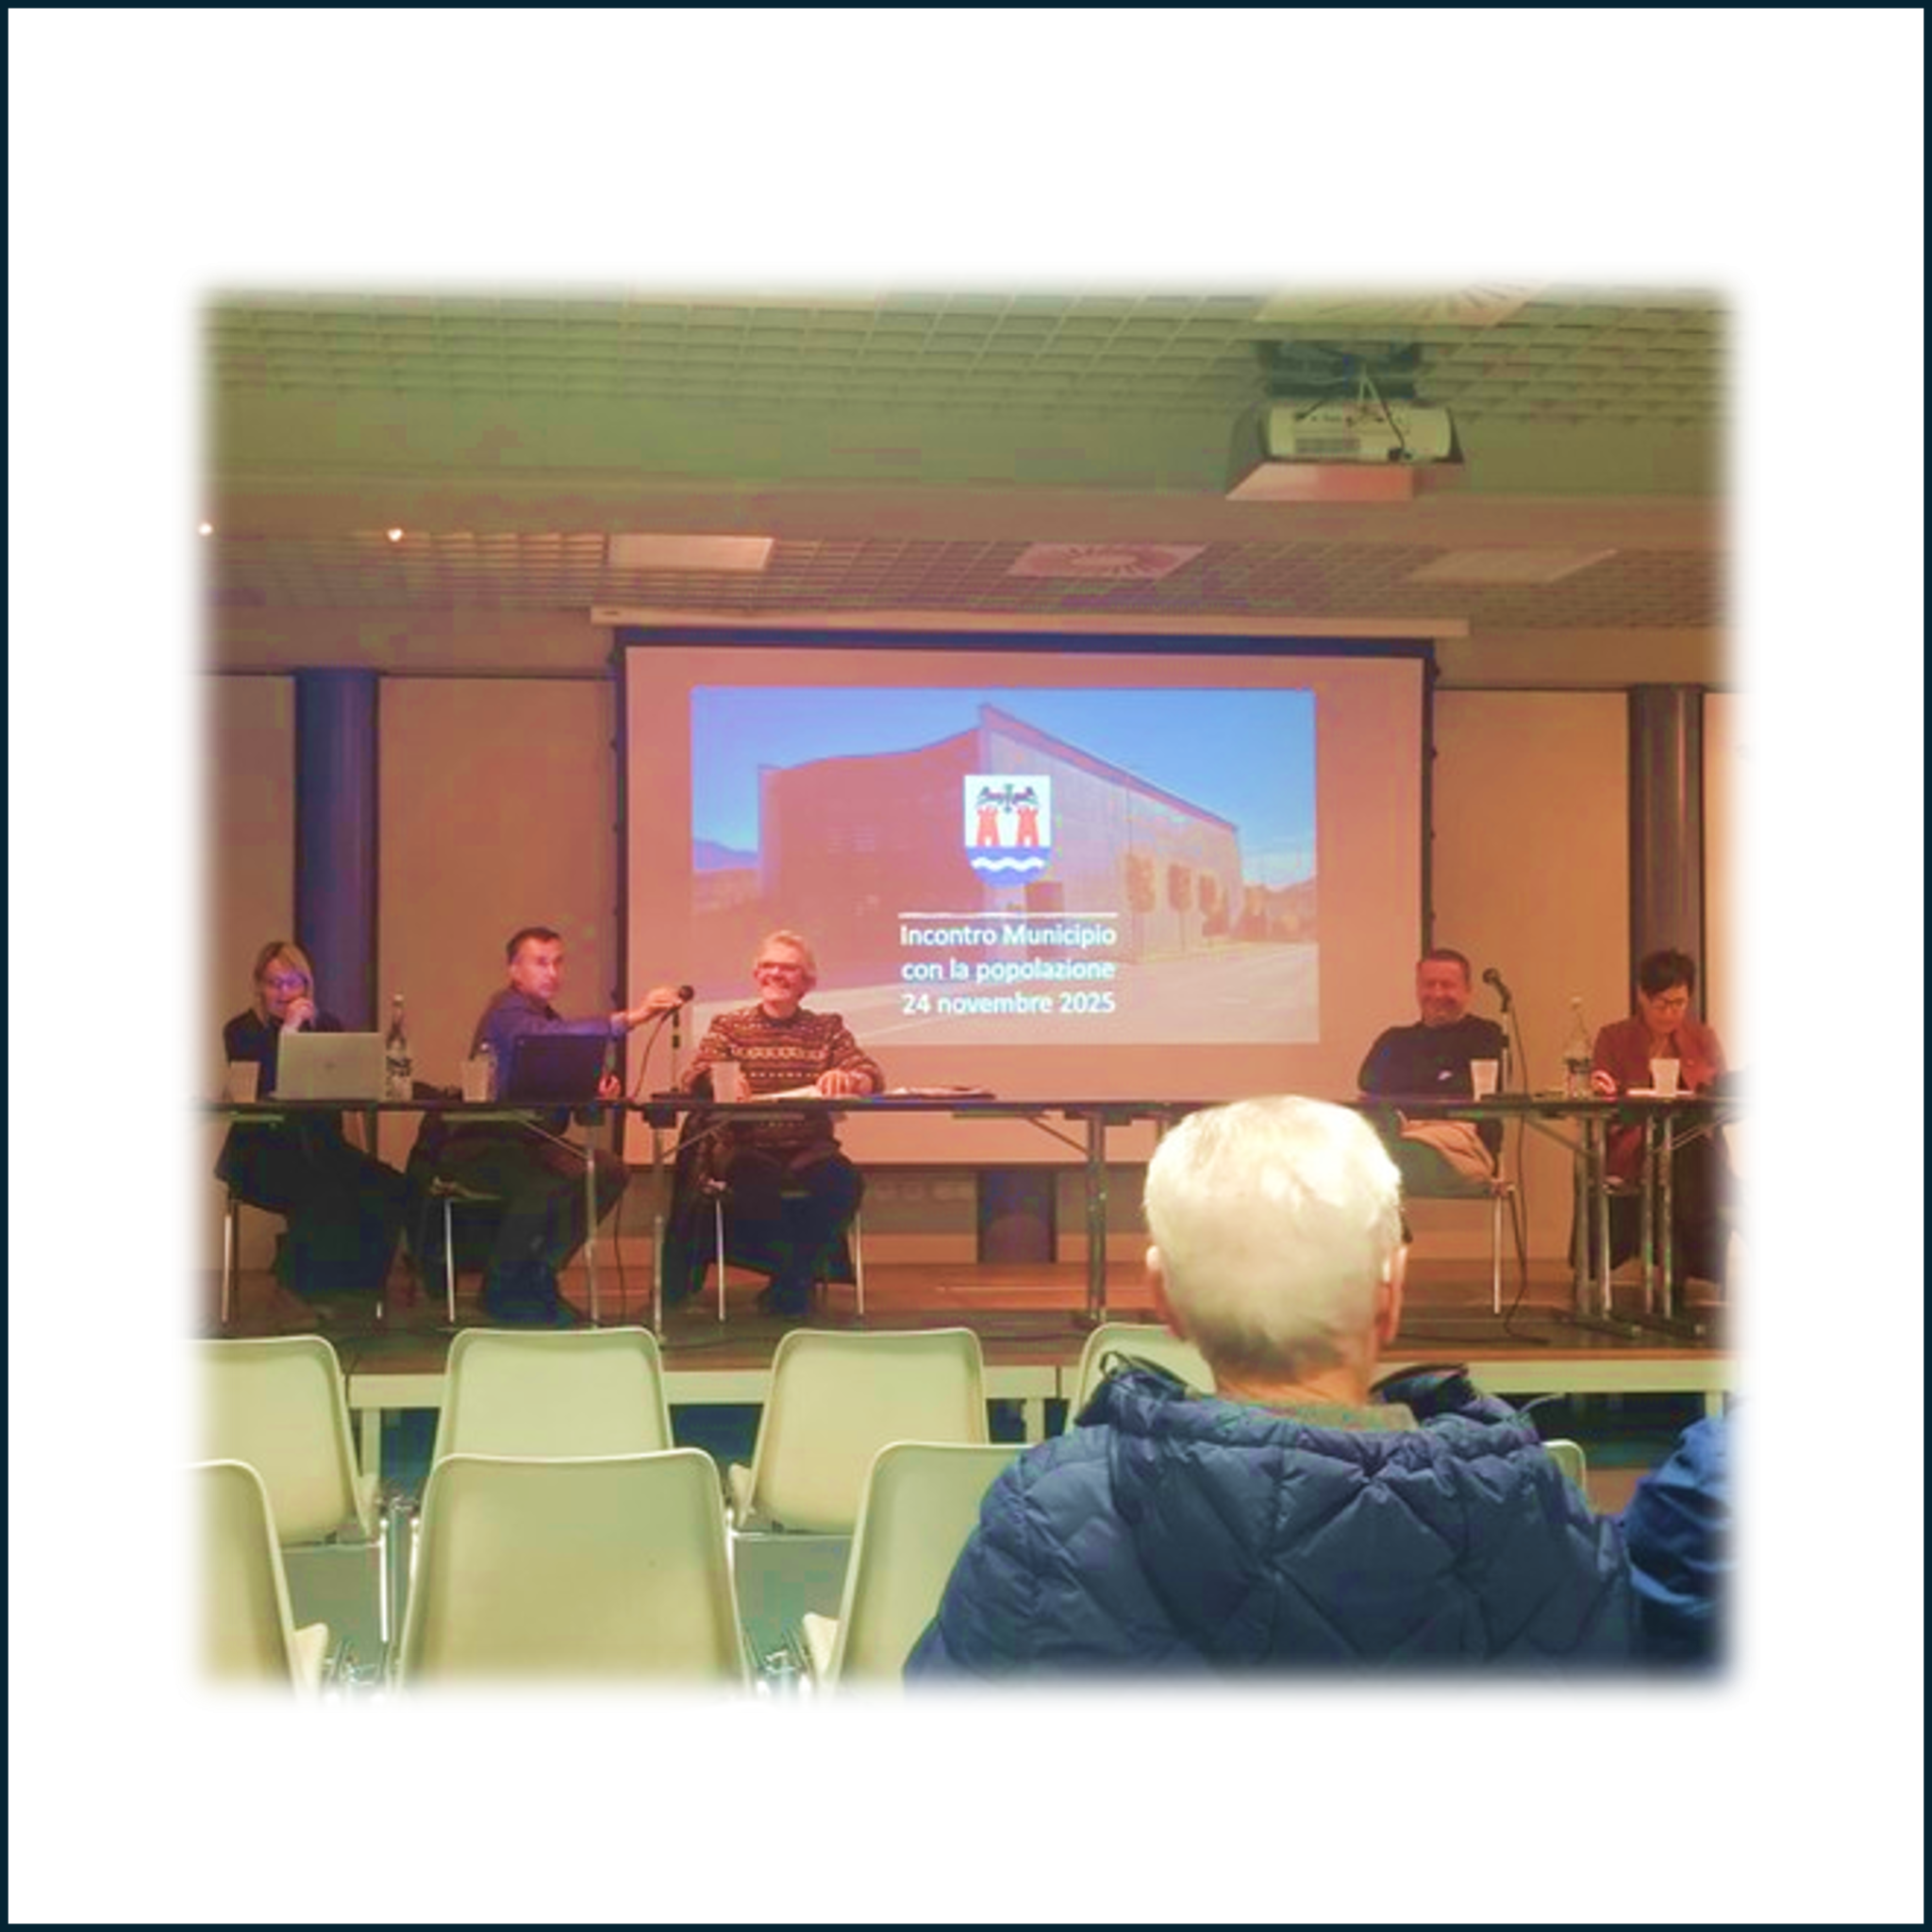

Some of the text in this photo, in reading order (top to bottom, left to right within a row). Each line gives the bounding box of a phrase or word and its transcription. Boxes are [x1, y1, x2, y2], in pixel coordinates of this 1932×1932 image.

[901, 924, 1118, 949] Incontro Municipio
[902, 957, 1116, 983] con la popolazione
[902, 991, 1115, 1014] 24 novembre 2025
